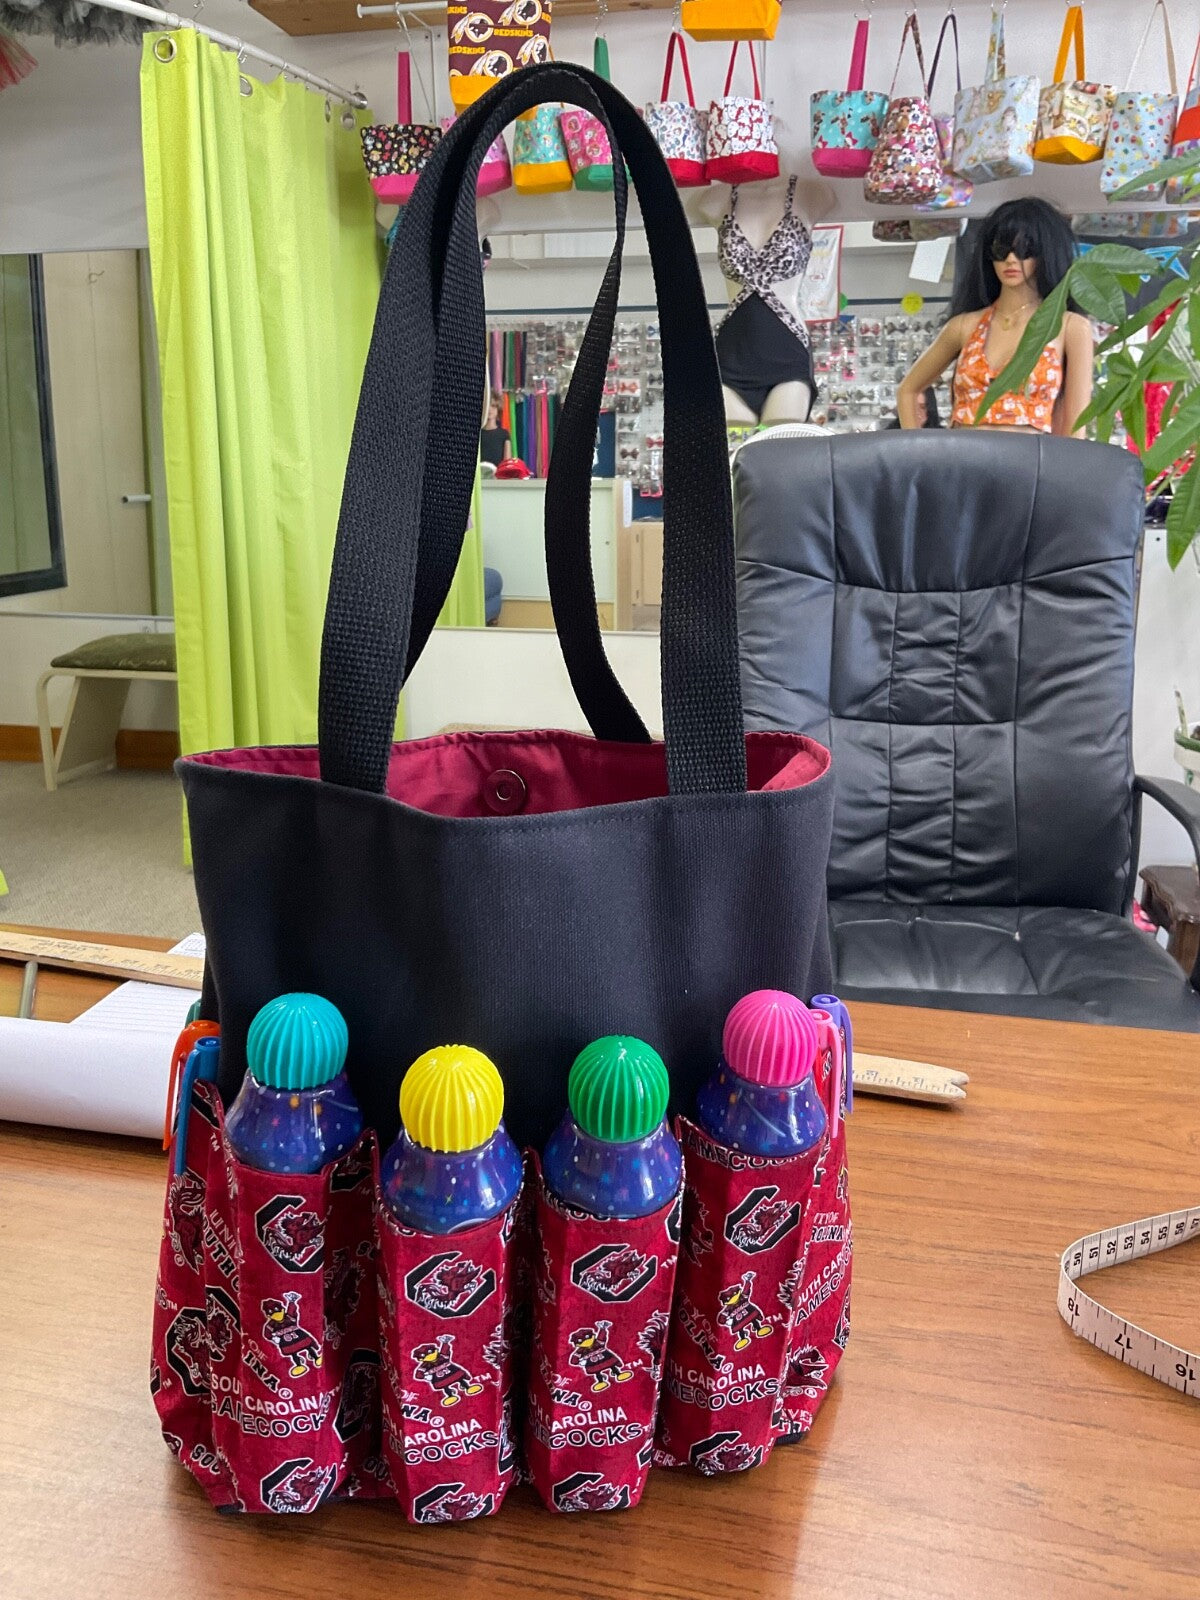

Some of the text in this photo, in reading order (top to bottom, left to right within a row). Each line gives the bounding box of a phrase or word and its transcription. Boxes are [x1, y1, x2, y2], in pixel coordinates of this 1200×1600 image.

[493, 28, 533, 37] REDSKINS
[1157, 1226, 1168, 1240] 55
[1174, 1221, 1185, 1236] 56
[1123, 1235, 1134, 1250] 53
[1140, 1230, 1151, 1245] 54
[1089, 1246, 1099, 1259] 51
[1106, 1240, 1117, 1255] 52
[1073, 1252, 1083, 1266] 50
[1067, 1297, 1081, 1317] 18
[1114, 1333, 1134, 1350] 17
[687, 1363, 766, 1392] CAROLINA
[1175, 1363, 1197, 1381] 16
